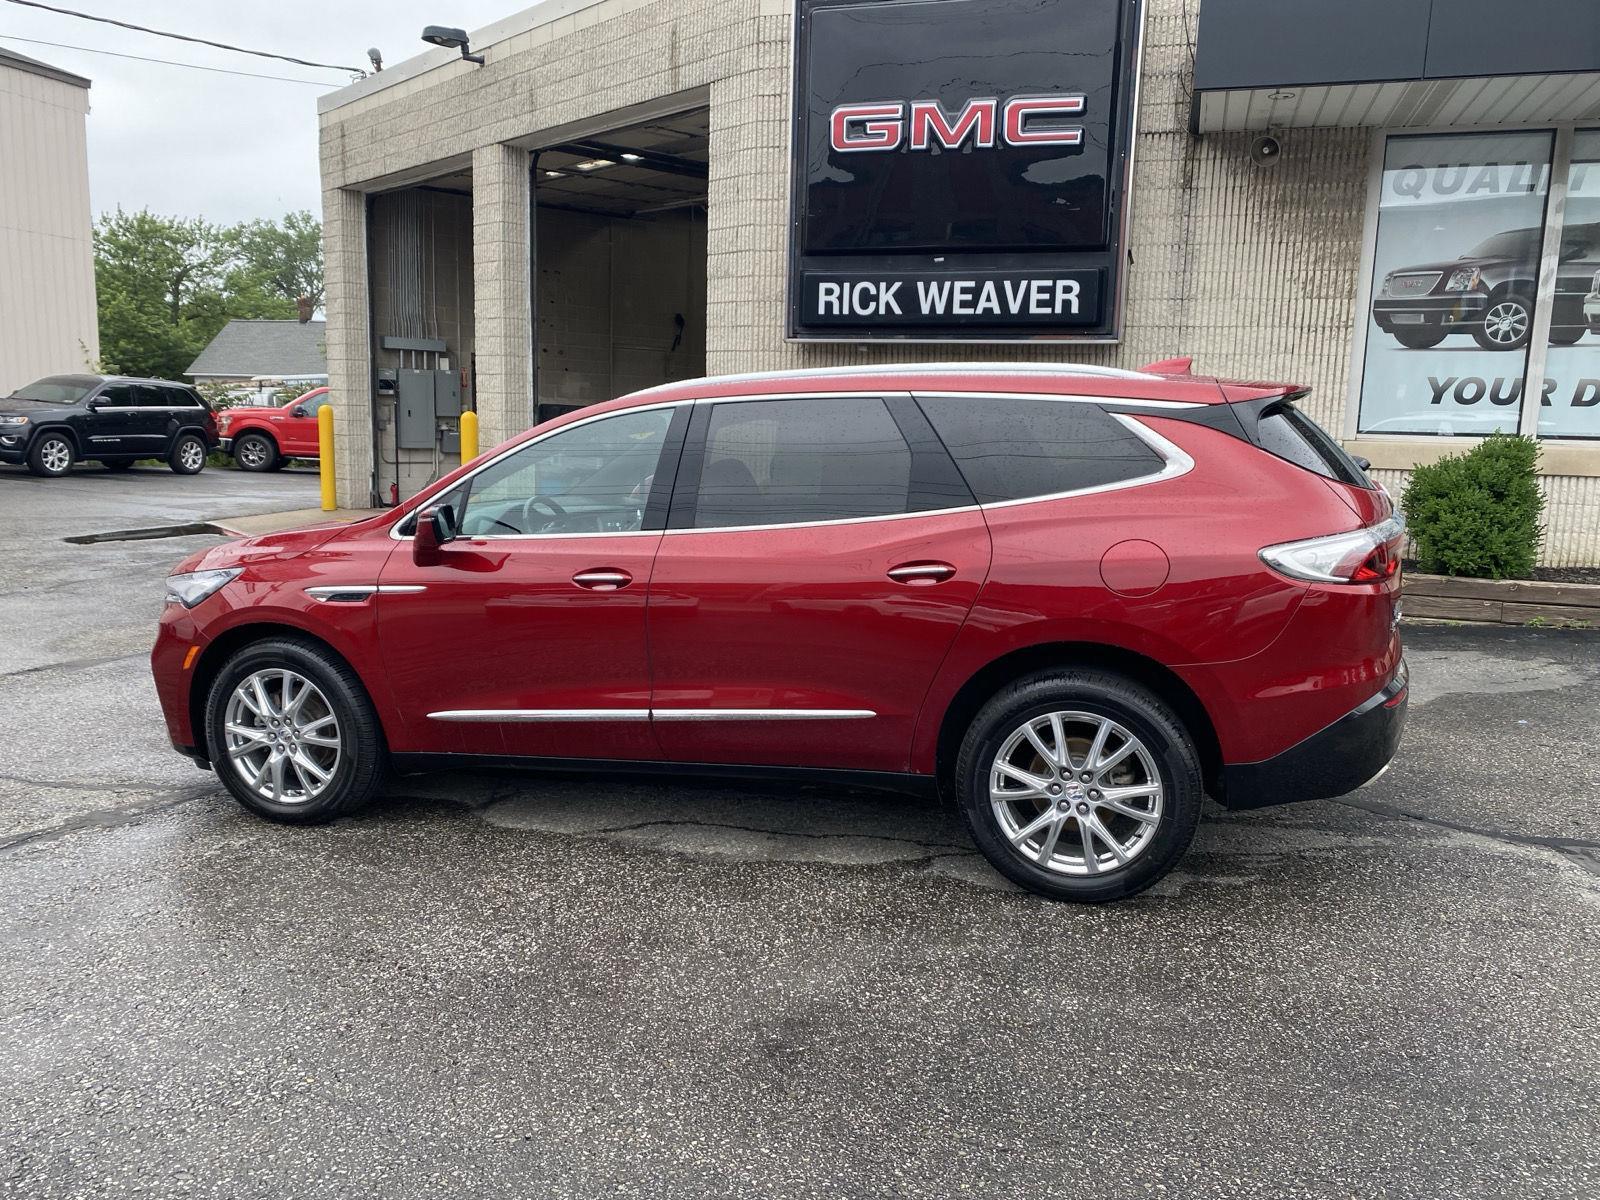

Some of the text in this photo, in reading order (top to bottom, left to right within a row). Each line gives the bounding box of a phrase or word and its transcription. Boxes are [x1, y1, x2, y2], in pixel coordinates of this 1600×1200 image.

[830, 95, 1086, 152] GMC
[818, 279, 1080, 315] RICK WEAVER
